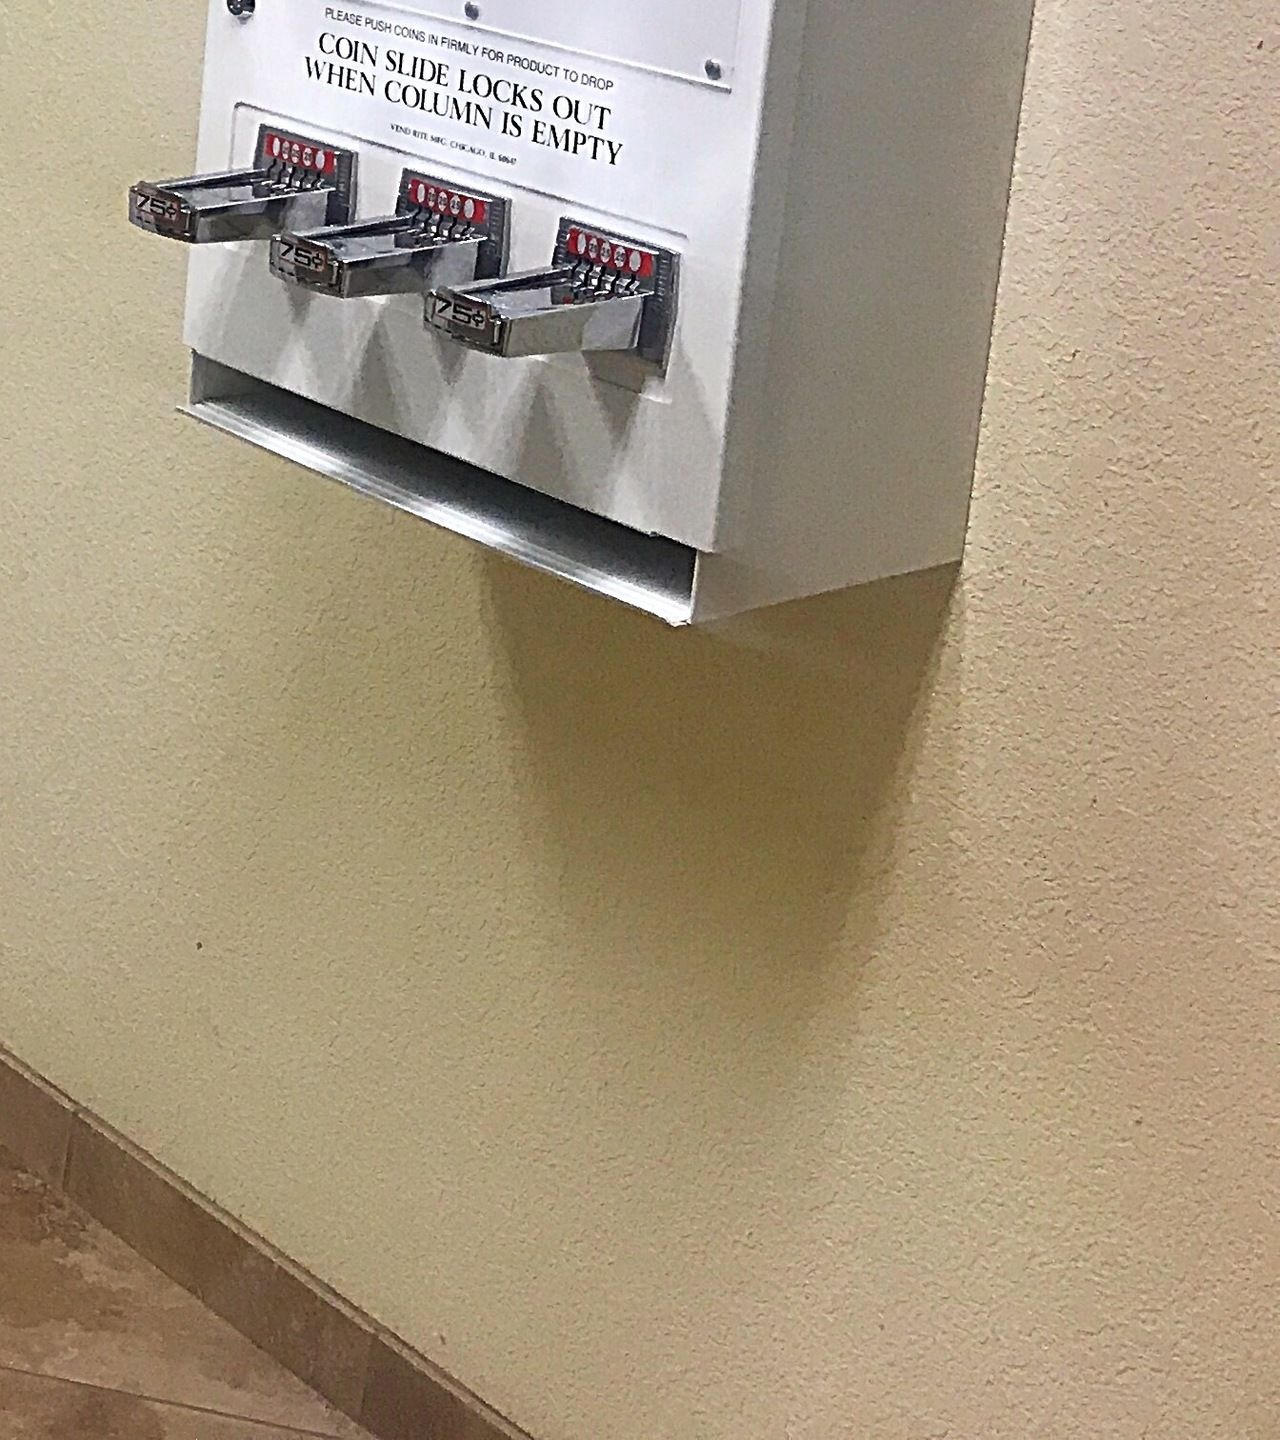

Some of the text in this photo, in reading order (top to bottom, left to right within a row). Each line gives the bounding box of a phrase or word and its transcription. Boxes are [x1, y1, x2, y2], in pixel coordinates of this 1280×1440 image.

[325, 7, 614, 91] PLEASE PUSH COINS IN FIRMLY FOR PRODUCT TO DROP
[318, 32, 612, 130] COIN SLIDE LOCKS OUT
[304, 56, 623, 166] WHEN COLUMN IS EMPTY
[390, 123, 411, 136] VEND
[412, 129, 429, 141] RITE
[135, 193, 176, 220] 75¢
[281, 241, 326, 271] 75¢
[434, 295, 484, 327] 75¢
